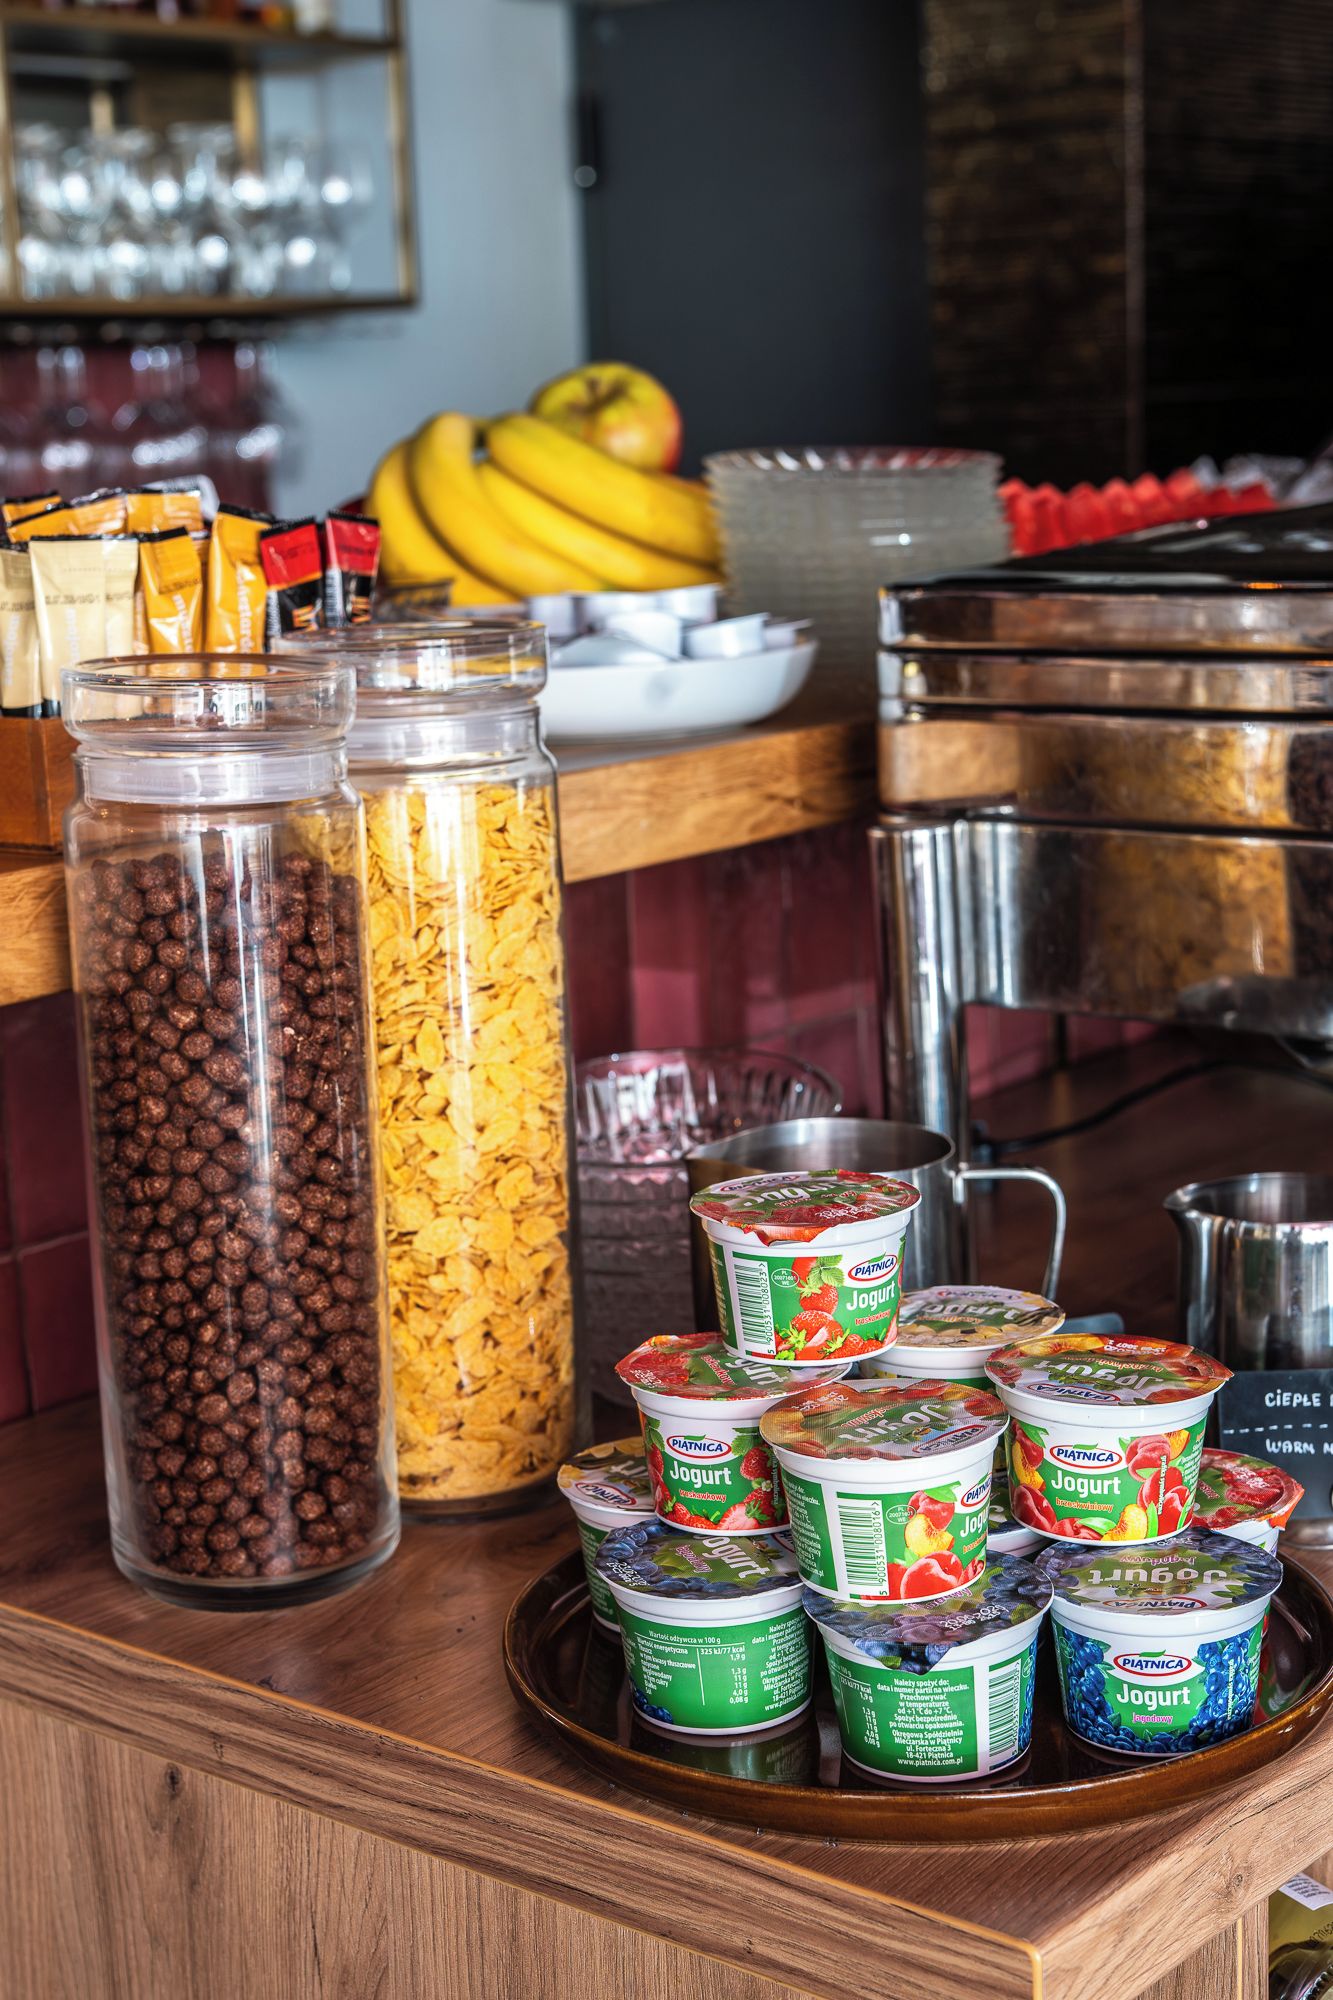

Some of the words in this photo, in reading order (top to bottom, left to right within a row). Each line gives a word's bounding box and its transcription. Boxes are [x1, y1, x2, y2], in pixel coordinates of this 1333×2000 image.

[854, 1256, 896, 1278] PIĄTNICA
[759, 1271, 769, 1303] 008023
[846, 1281, 896, 1311] Jogurt
[762, 1309, 773, 1342] 900531
[1033, 1360, 1165, 1390] Jogurt
[837, 1404, 949, 1444] Jogurt
[672, 1437, 724, 1453] PIĄTNICA
[1056, 1447, 1115, 1463] PIĄTNICA
[669, 1461, 732, 1488] Jogurt
[1050, 1469, 1121, 1499] Jogurt
[679, 1489, 727, 1503] truskawkowy
[1055, 1497, 1114, 1514] brzoskwiniowy
[872, 1510, 883, 1545] 008016
[959, 1510, 989, 1538] Jogu
[874, 1549, 888, 1584] 900531
[1087, 1567, 1228, 1584] Jogurt
[1113, 1600, 1196, 1609] PIĄTNICA
[700, 1647, 713, 1655] 325
[730, 1653, 741, 1661] 1,9
[1122, 1658, 1185, 1671] PIĄTNICA
[876, 1682, 891, 1692] data
[915, 1686, 933, 1695] partii
[942, 1683, 970, 1693] wieczku.
[893, 1678, 916, 1688] Należy
[915, 1678, 938, 1688] spożyć
[732, 1689, 743, 1697] 4,0
[899, 1693, 947, 1701] Przechowywać
[1116, 1683, 1191, 1711] Jogurt
[905, 1700, 950, 1709] temperaturze
[894, 1713, 916, 1723] Spożyć
[915, 1714, 958, 1723] bezpośrednio
[897, 1721, 924, 1730] otwarciu
[924, 1719, 965, 1730] opakowania.
[1132, 1712, 1174, 1724] jagodowy
[891, 1729, 924, 1739] Okręgowa
[924, 1729, 964, 1740] Spółdzielnia
[894, 1737, 929, 1745] Mleczarska
[936, 1736, 963, 1746] Piątnicy
[915, 1744, 947, 1752] Forteczna
[897, 1756, 963, 1767] www.piatnica.com.pl
[905, 1751, 927, 1759] 18-421
[927, 1751, 954, 1760] Piątnica
